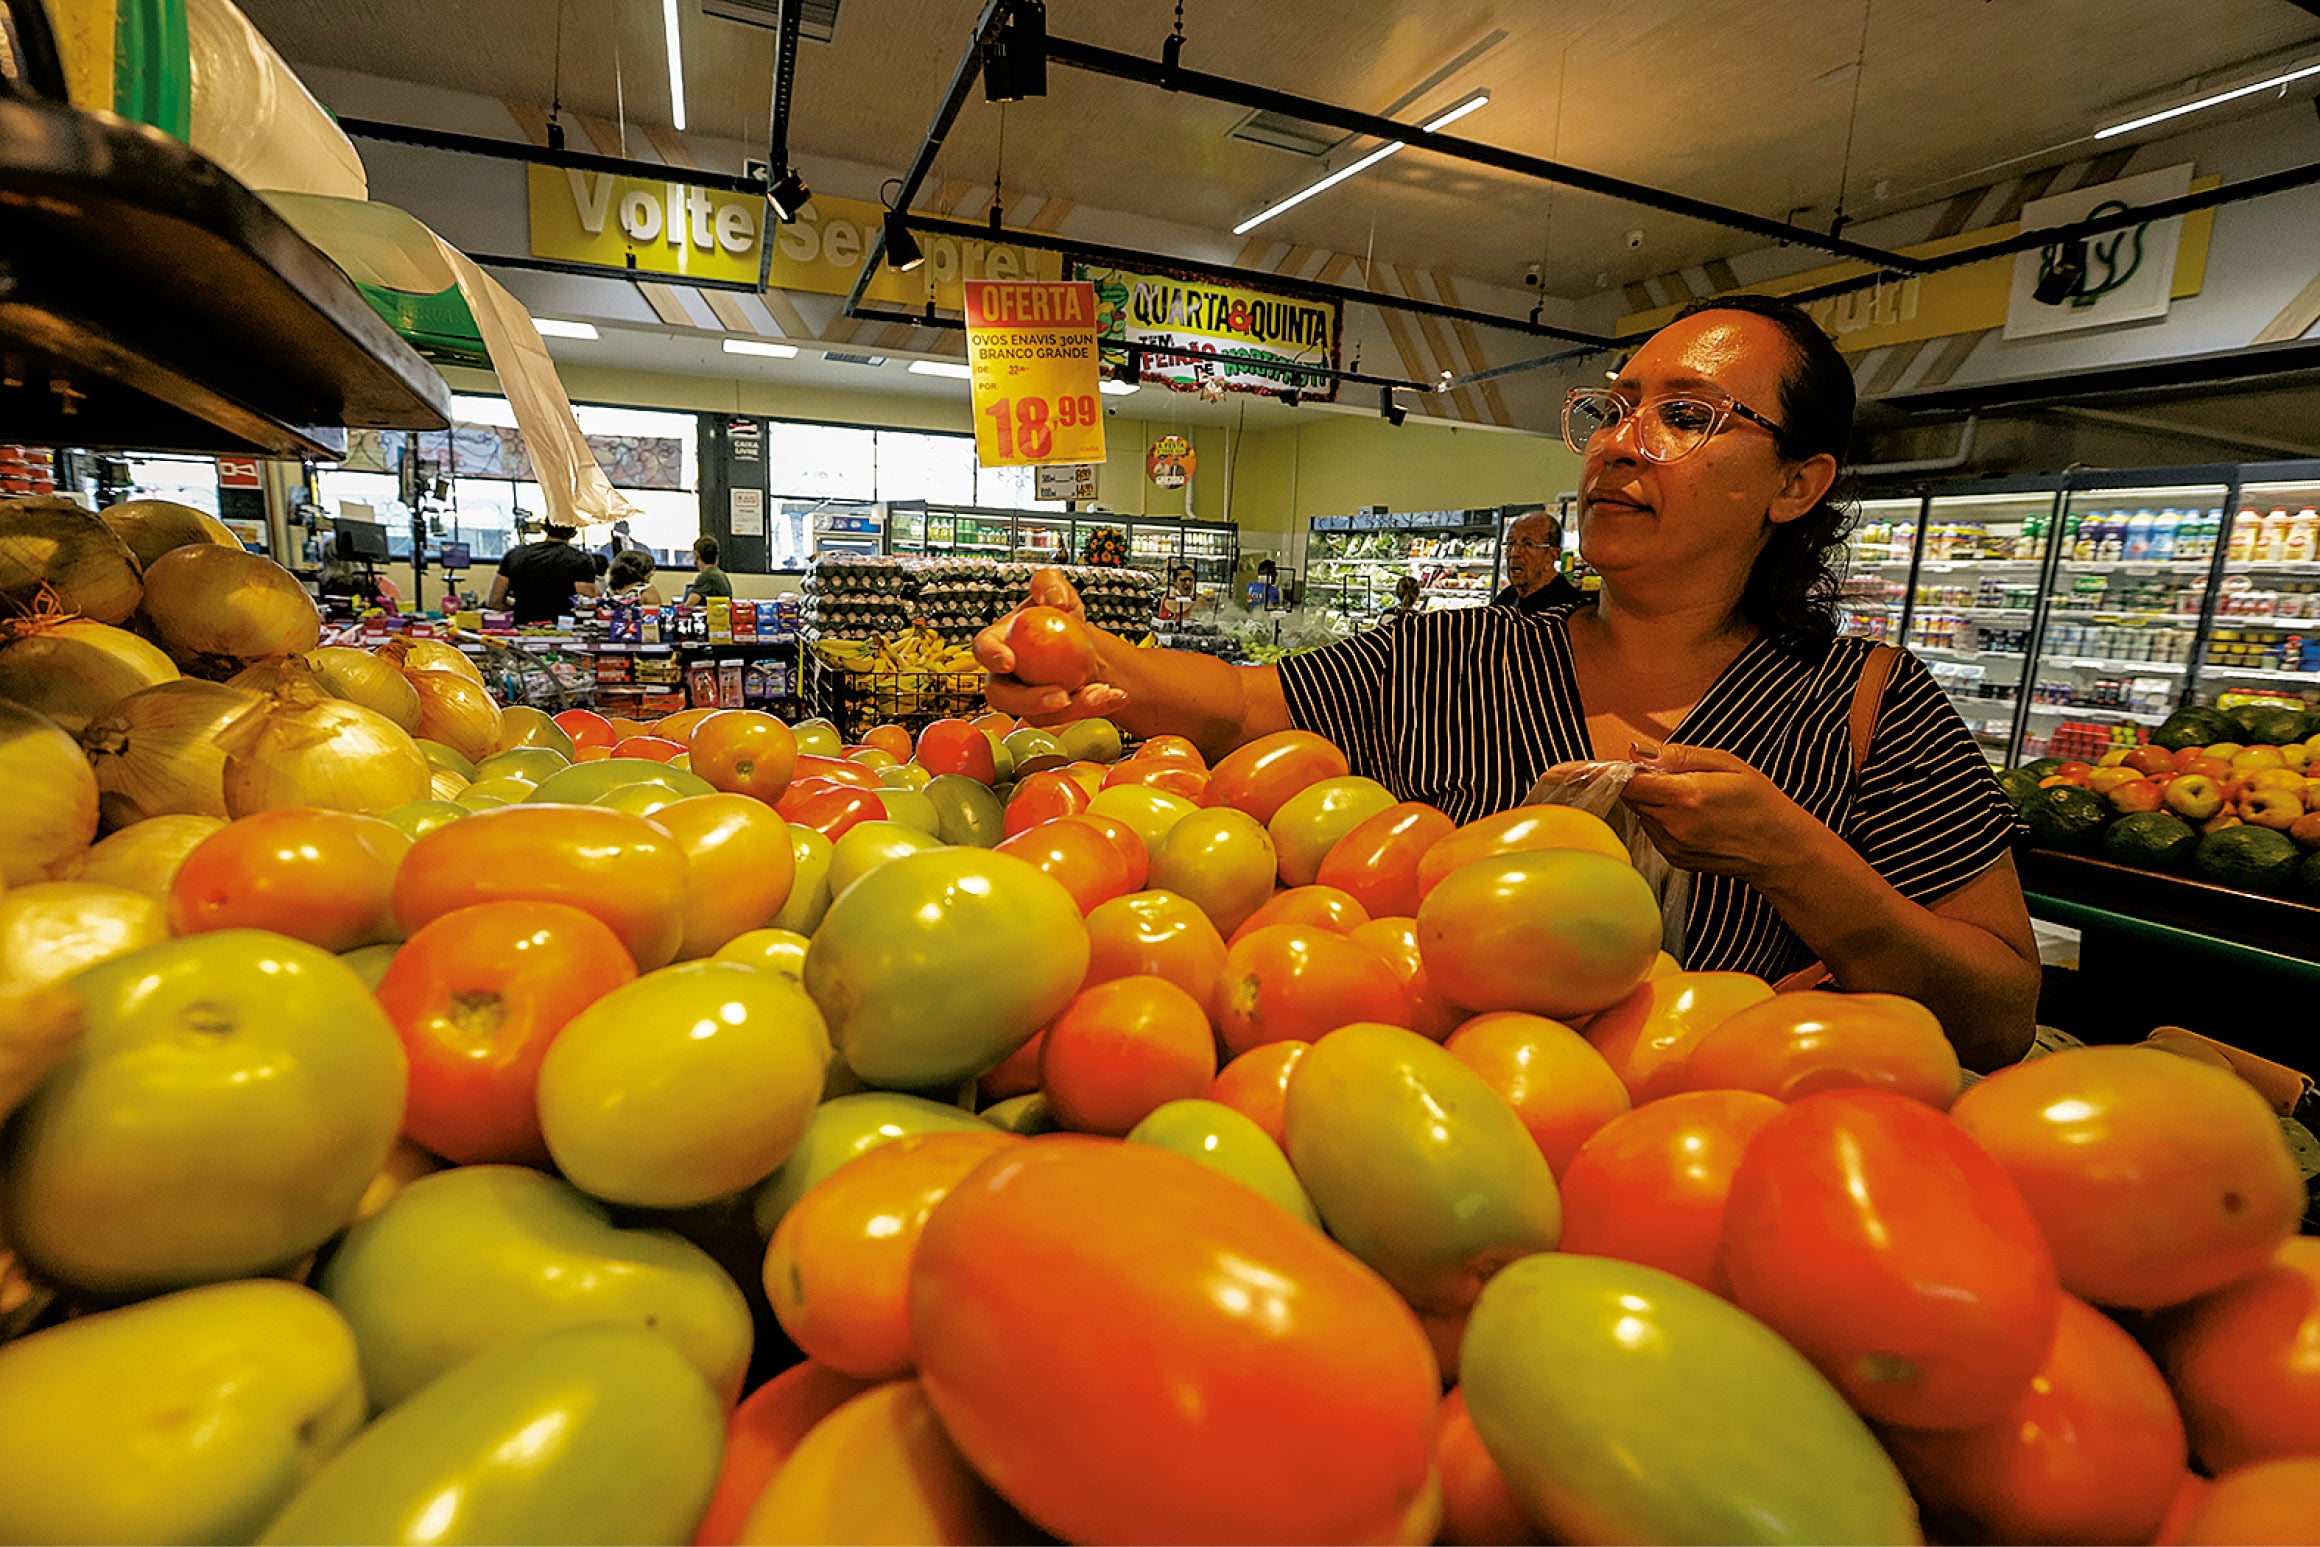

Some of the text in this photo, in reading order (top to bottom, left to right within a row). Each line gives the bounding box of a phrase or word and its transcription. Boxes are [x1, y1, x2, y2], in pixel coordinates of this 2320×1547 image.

[565, 168, 1041, 297] Volte Sepre!
[982, 285, 1082, 321] OFERTA
[972, 334, 1093, 346] OVOS ENAVIS 30UN
[980, 347, 1089, 359] BRANCO GRANDE
[985, 395, 1097, 459] 18,99
